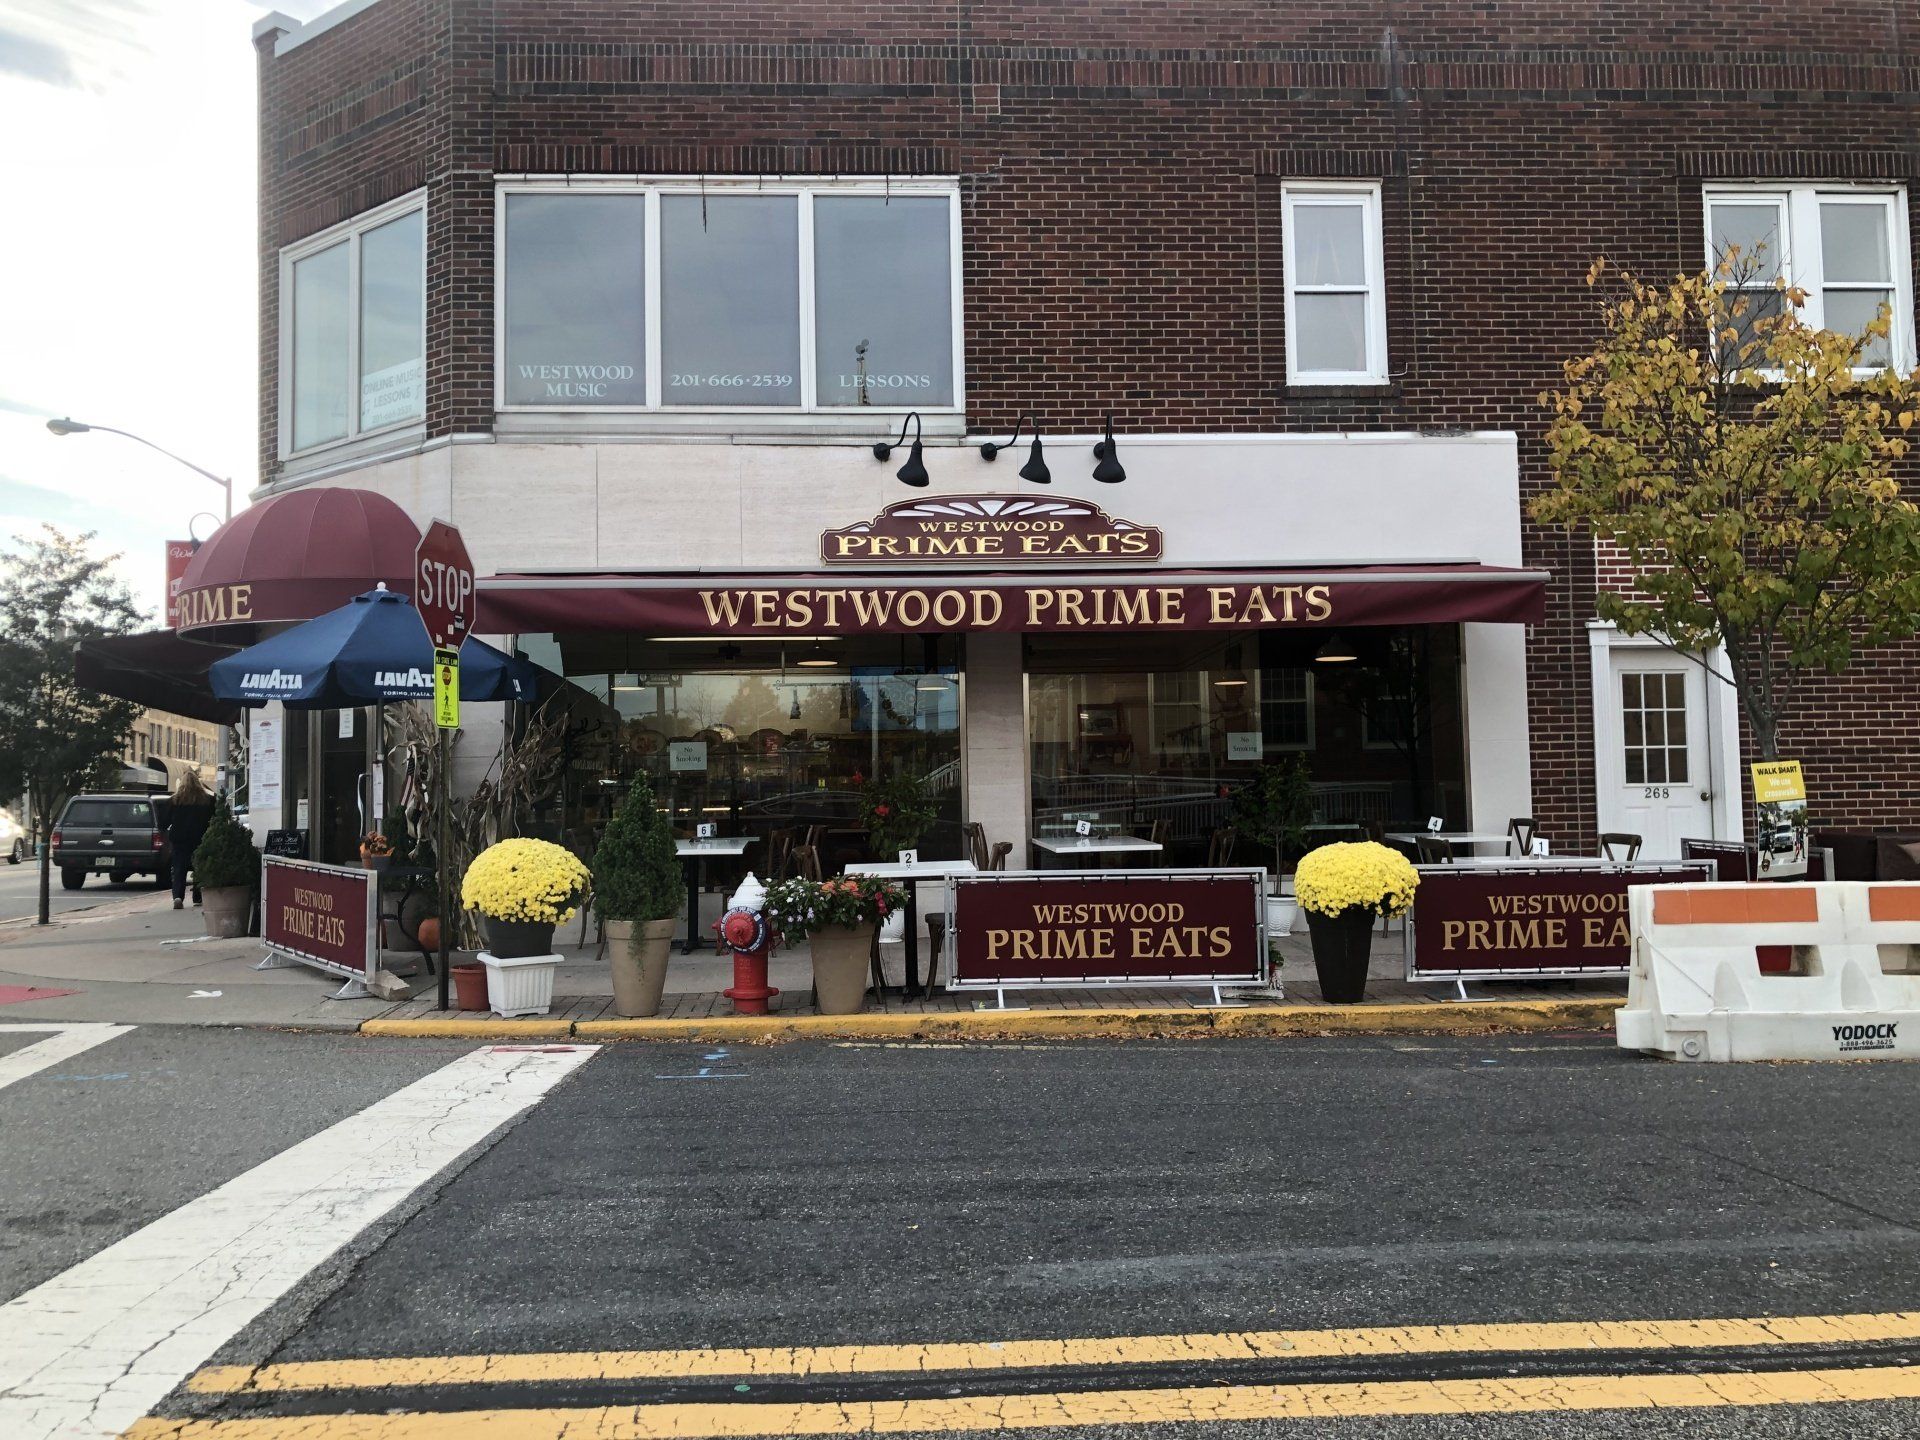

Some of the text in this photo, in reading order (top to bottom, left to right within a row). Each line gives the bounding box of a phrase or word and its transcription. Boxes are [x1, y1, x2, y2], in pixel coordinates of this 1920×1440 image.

[363, 367, 422, 394] ONLINE MUSIC
[518, 365, 634, 380] WESTWOOD
[839, 374, 931, 388] LESSONS
[374, 387, 411, 407] LESSONS
[546, 382, 607, 397] MUSIC
[918, 521, 1065, 533] WESTWOOD
[835, 532, 1149, 556] PRIME EATS
[421, 559, 471, 612] STOP
[698, 585, 1332, 627] WESTWOOD PRIME EATS
[240, 669, 302, 689] LAVAZZA
[1778, 766, 1797, 774] SMART
[1645, 787, 1669, 798] 268
[702, 826, 707, 835] 6
[1081, 823, 1086, 832] 5
[905, 853, 911, 863] 2
[294, 888, 333, 912] WESTWOOD
[1033, 903, 1184, 924] WESTWOOD
[283, 906, 345, 947] PRIME EATS
[1442, 917, 1631, 950] PRIME EA
[986, 926, 1232, 960] PRIME EATS
[1832, 1024, 1897, 1040] YODOCK
